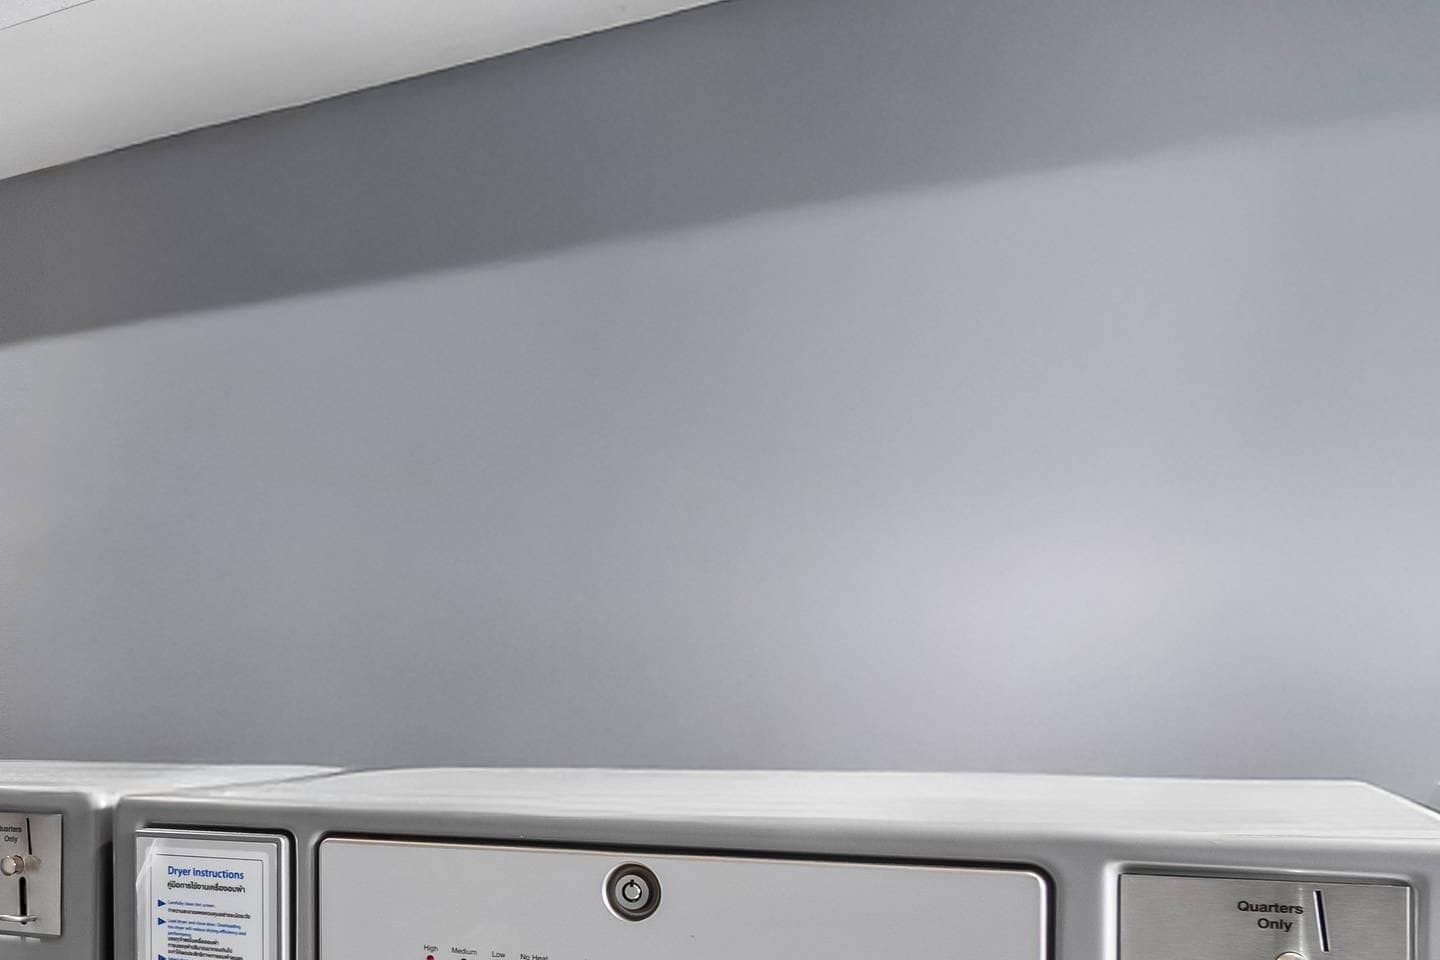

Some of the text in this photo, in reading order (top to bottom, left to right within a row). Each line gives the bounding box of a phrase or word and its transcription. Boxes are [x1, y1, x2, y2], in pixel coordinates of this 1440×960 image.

[4, 835, 18, 844] Only
[168, 866, 244, 880] Dryer Instructions
[1238, 901, 1304, 914] Quarters
[1257, 918, 1293, 932] Only
[424, 945, 438, 953] High
[452, 947, 477, 955] Medium
[492, 951, 506, 959] Low
